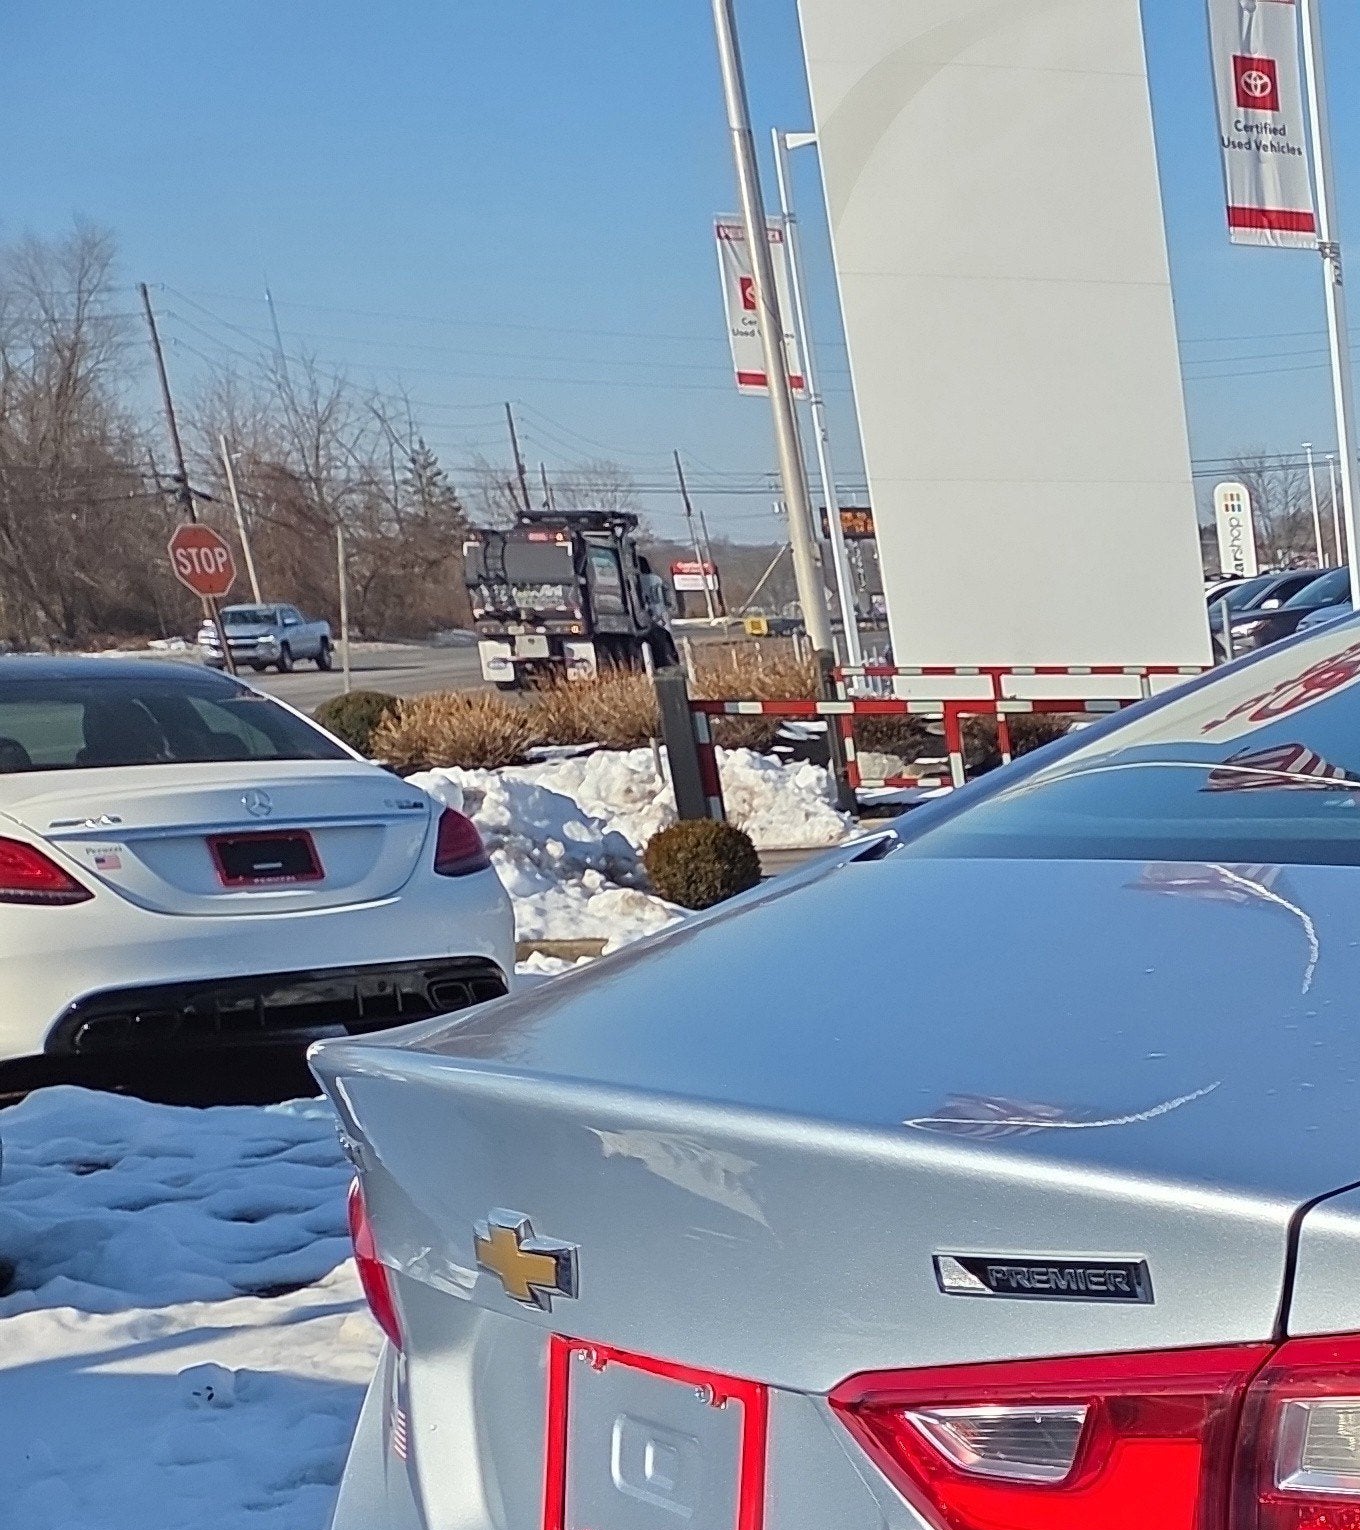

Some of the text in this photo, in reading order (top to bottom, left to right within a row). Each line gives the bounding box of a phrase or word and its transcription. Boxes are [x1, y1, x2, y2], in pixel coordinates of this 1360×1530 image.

[1234, 119, 1287, 137] Certified
[1221, 135, 1303, 156] Used Vehicles
[1228, 517, 1245, 575] arshop
[176, 546, 228, 576] STOP
[987, 1265, 1131, 1292] PREMIER
